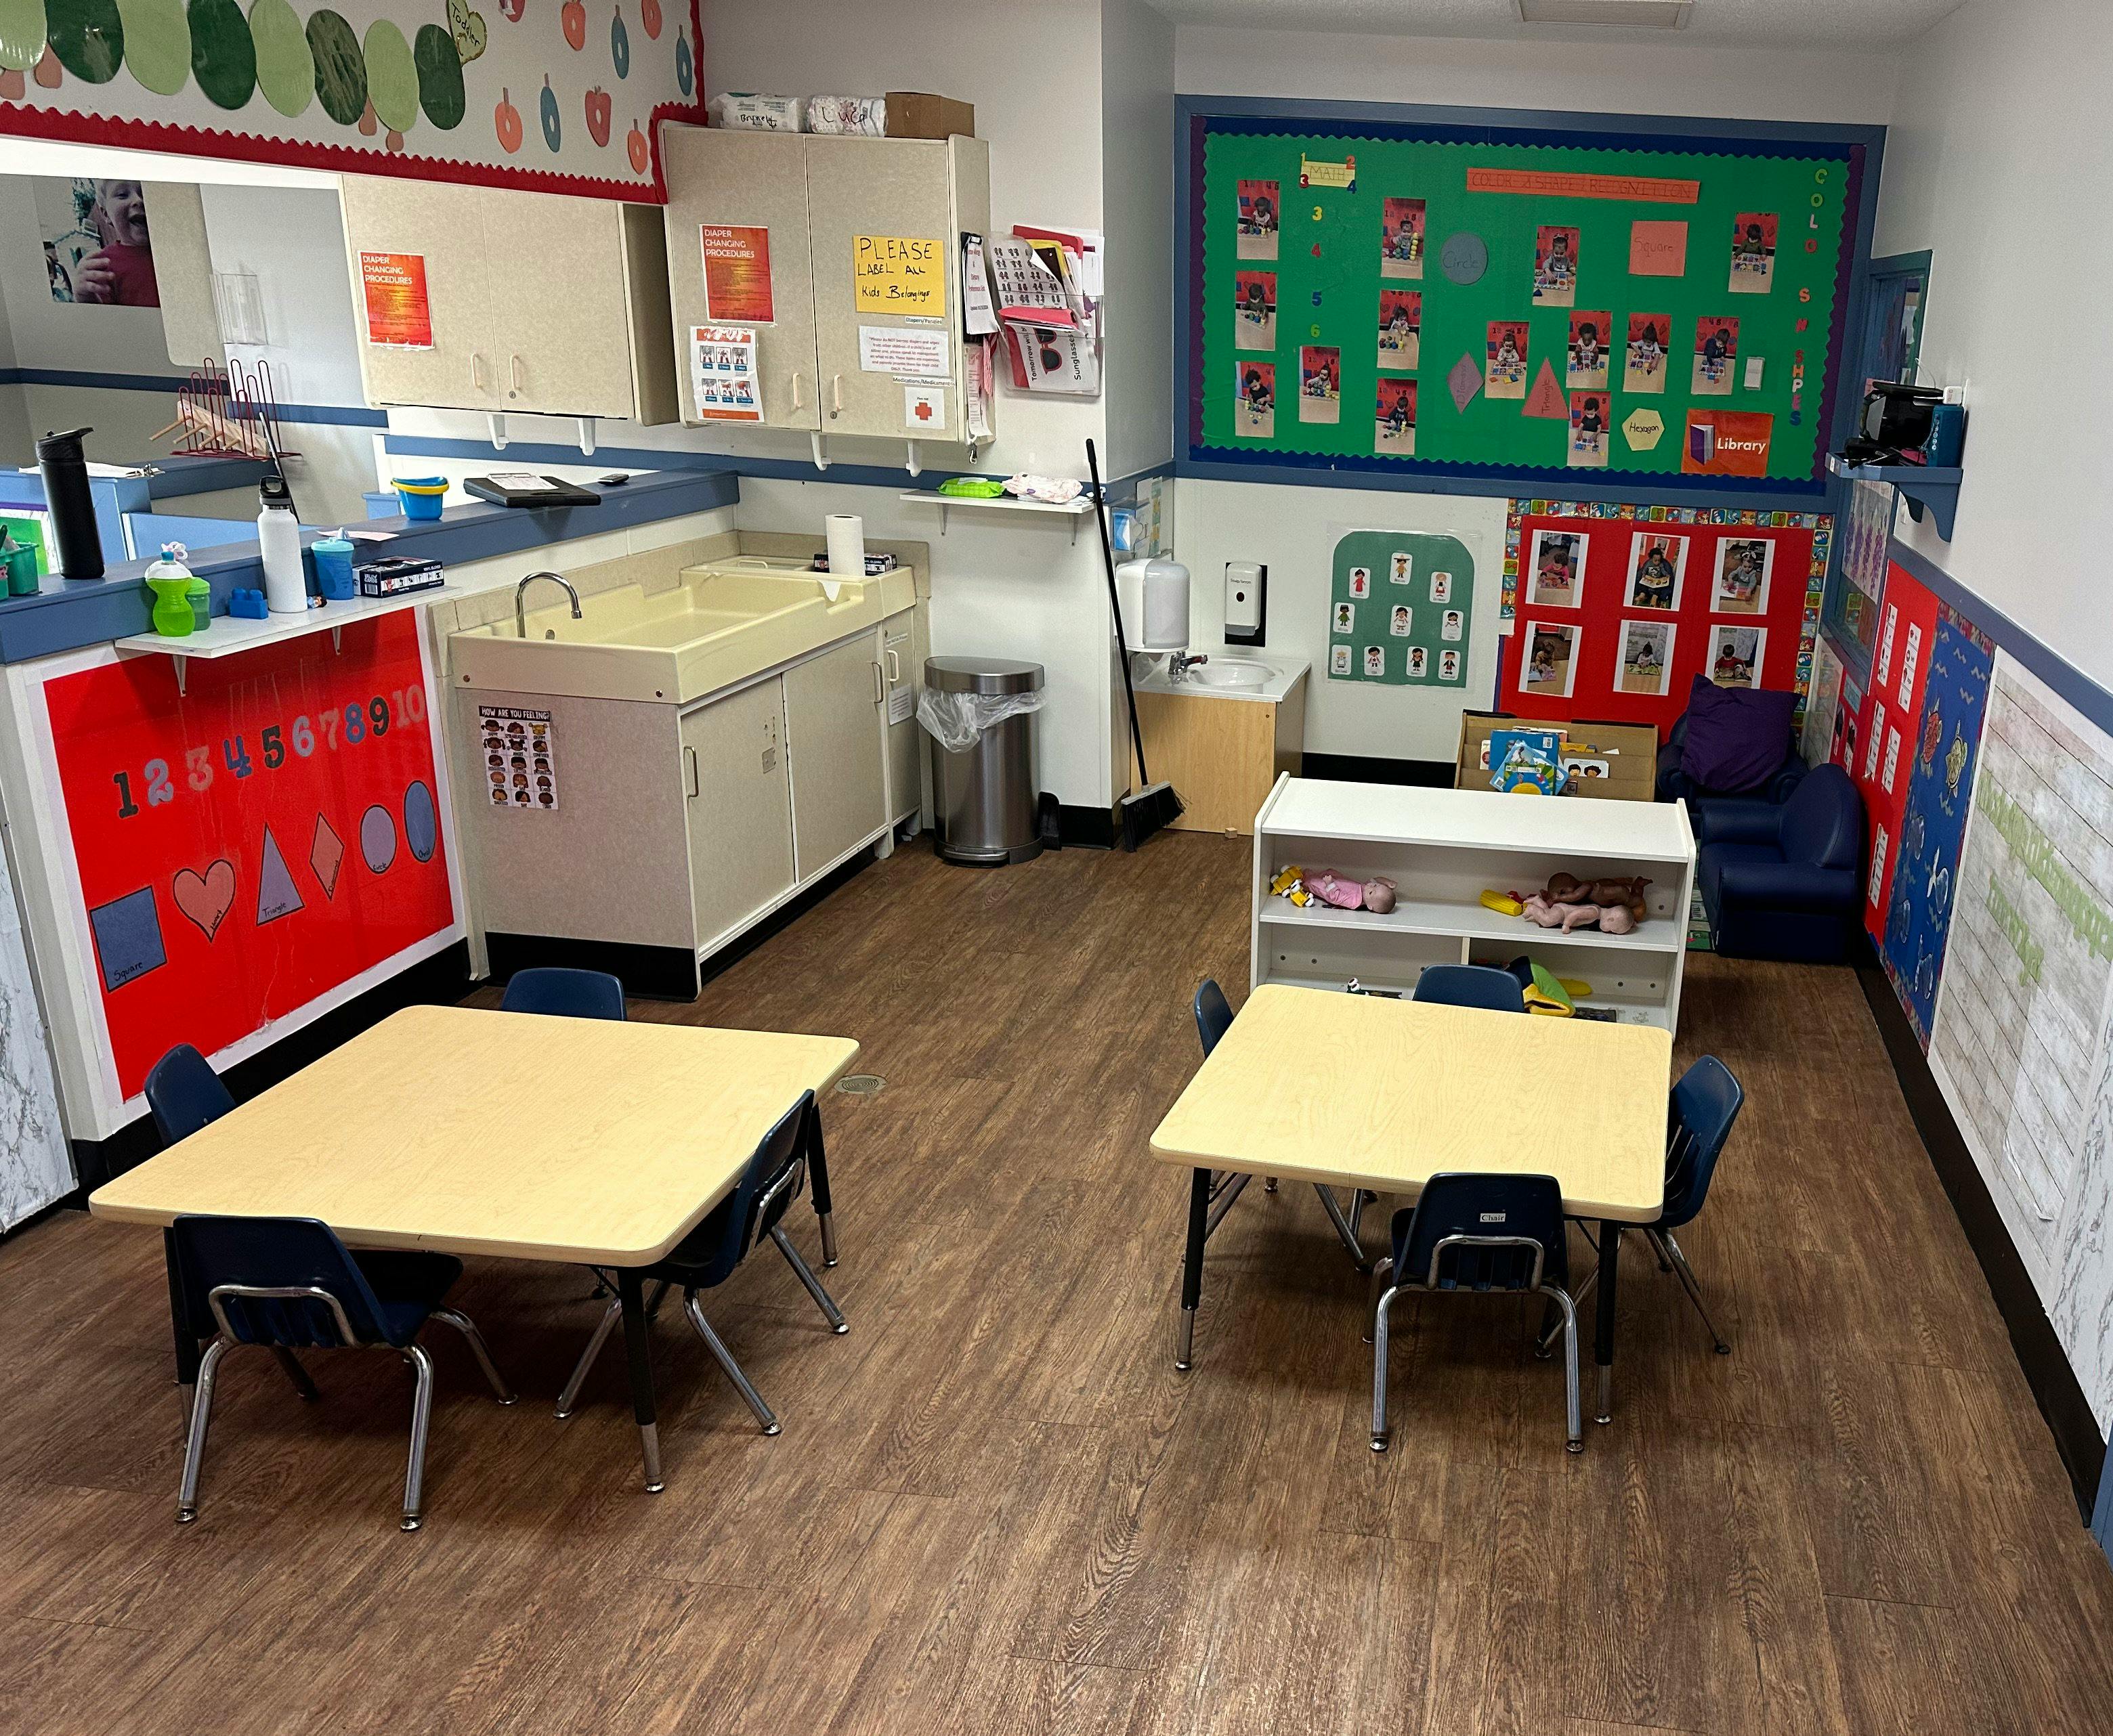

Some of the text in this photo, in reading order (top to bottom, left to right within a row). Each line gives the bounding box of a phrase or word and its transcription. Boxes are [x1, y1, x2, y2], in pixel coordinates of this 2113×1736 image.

[452, 2, 480, 47] Toddler
[1346, 155, 1356, 170] 2
[1309, 166, 1345, 181] MATH
[1300, 174, 1357, 194] 3 4
[1472, 173, 1512, 187] COLOR
[1535, 179, 1573, 191] SHAPE
[1312, 206, 1323, 221] 3
[704, 229, 732, 238] DIAPER
[705, 239, 746, 248] CHANGING
[859, 237, 933, 260] PLEASE
[1311, 243, 1321, 257] 4
[1634, 237, 1673, 257] Square
[362, 255, 391, 265] DIAPER
[706, 248, 754, 259] PROCEDURES
[1443, 251, 1480, 269] Circle
[364, 265, 404, 275] CHANGING
[857, 263, 894, 277] LABEL
[364, 274, 412, 285] PROCEDURES
[861, 285, 931, 302] Kids Belongings
[1312, 290, 1322, 306] 5
[1310, 324, 1321, 338] 6
[1026, 345, 1038, 381] Tomorrow
[1067, 334, 1082, 381] Sunglasses
[1541, 378, 1554, 414] Triangle
[1629, 421, 1660, 435] Hexagon
[1717, 437, 1766, 455] Library
[482, 706, 551, 720] HOW ARE YOU FEELING?
[113, 685, 425, 819] 1 2 3 4 5 6 7 8 9 10
[262, 901, 287, 919] Triangle
[112, 961, 144, 982] Square
